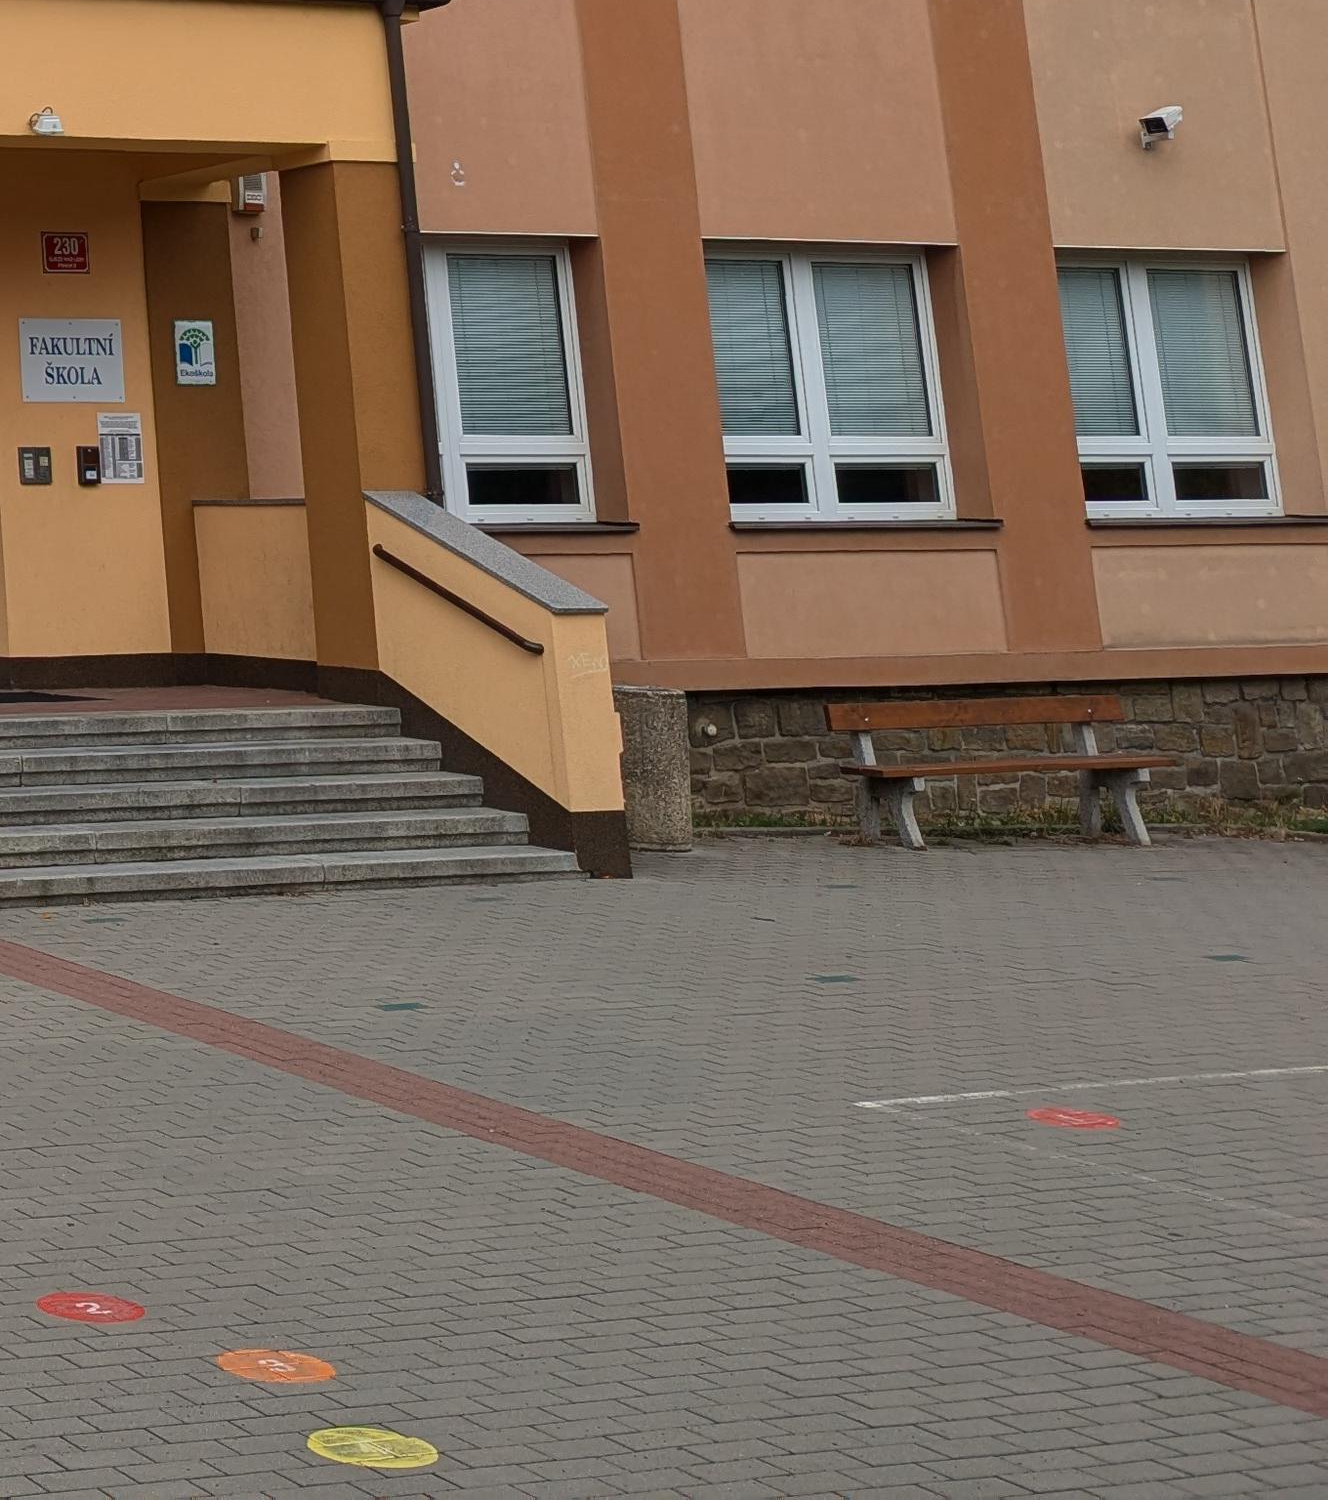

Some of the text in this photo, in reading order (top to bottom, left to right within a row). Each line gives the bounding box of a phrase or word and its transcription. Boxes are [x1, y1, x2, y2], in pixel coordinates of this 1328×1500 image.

[54, 237, 79, 255] 230
[28, 333, 114, 356] FAKULTNÍ
[45, 361, 102, 386] ŠKOLA
[75, 1302, 113, 1315] 2
